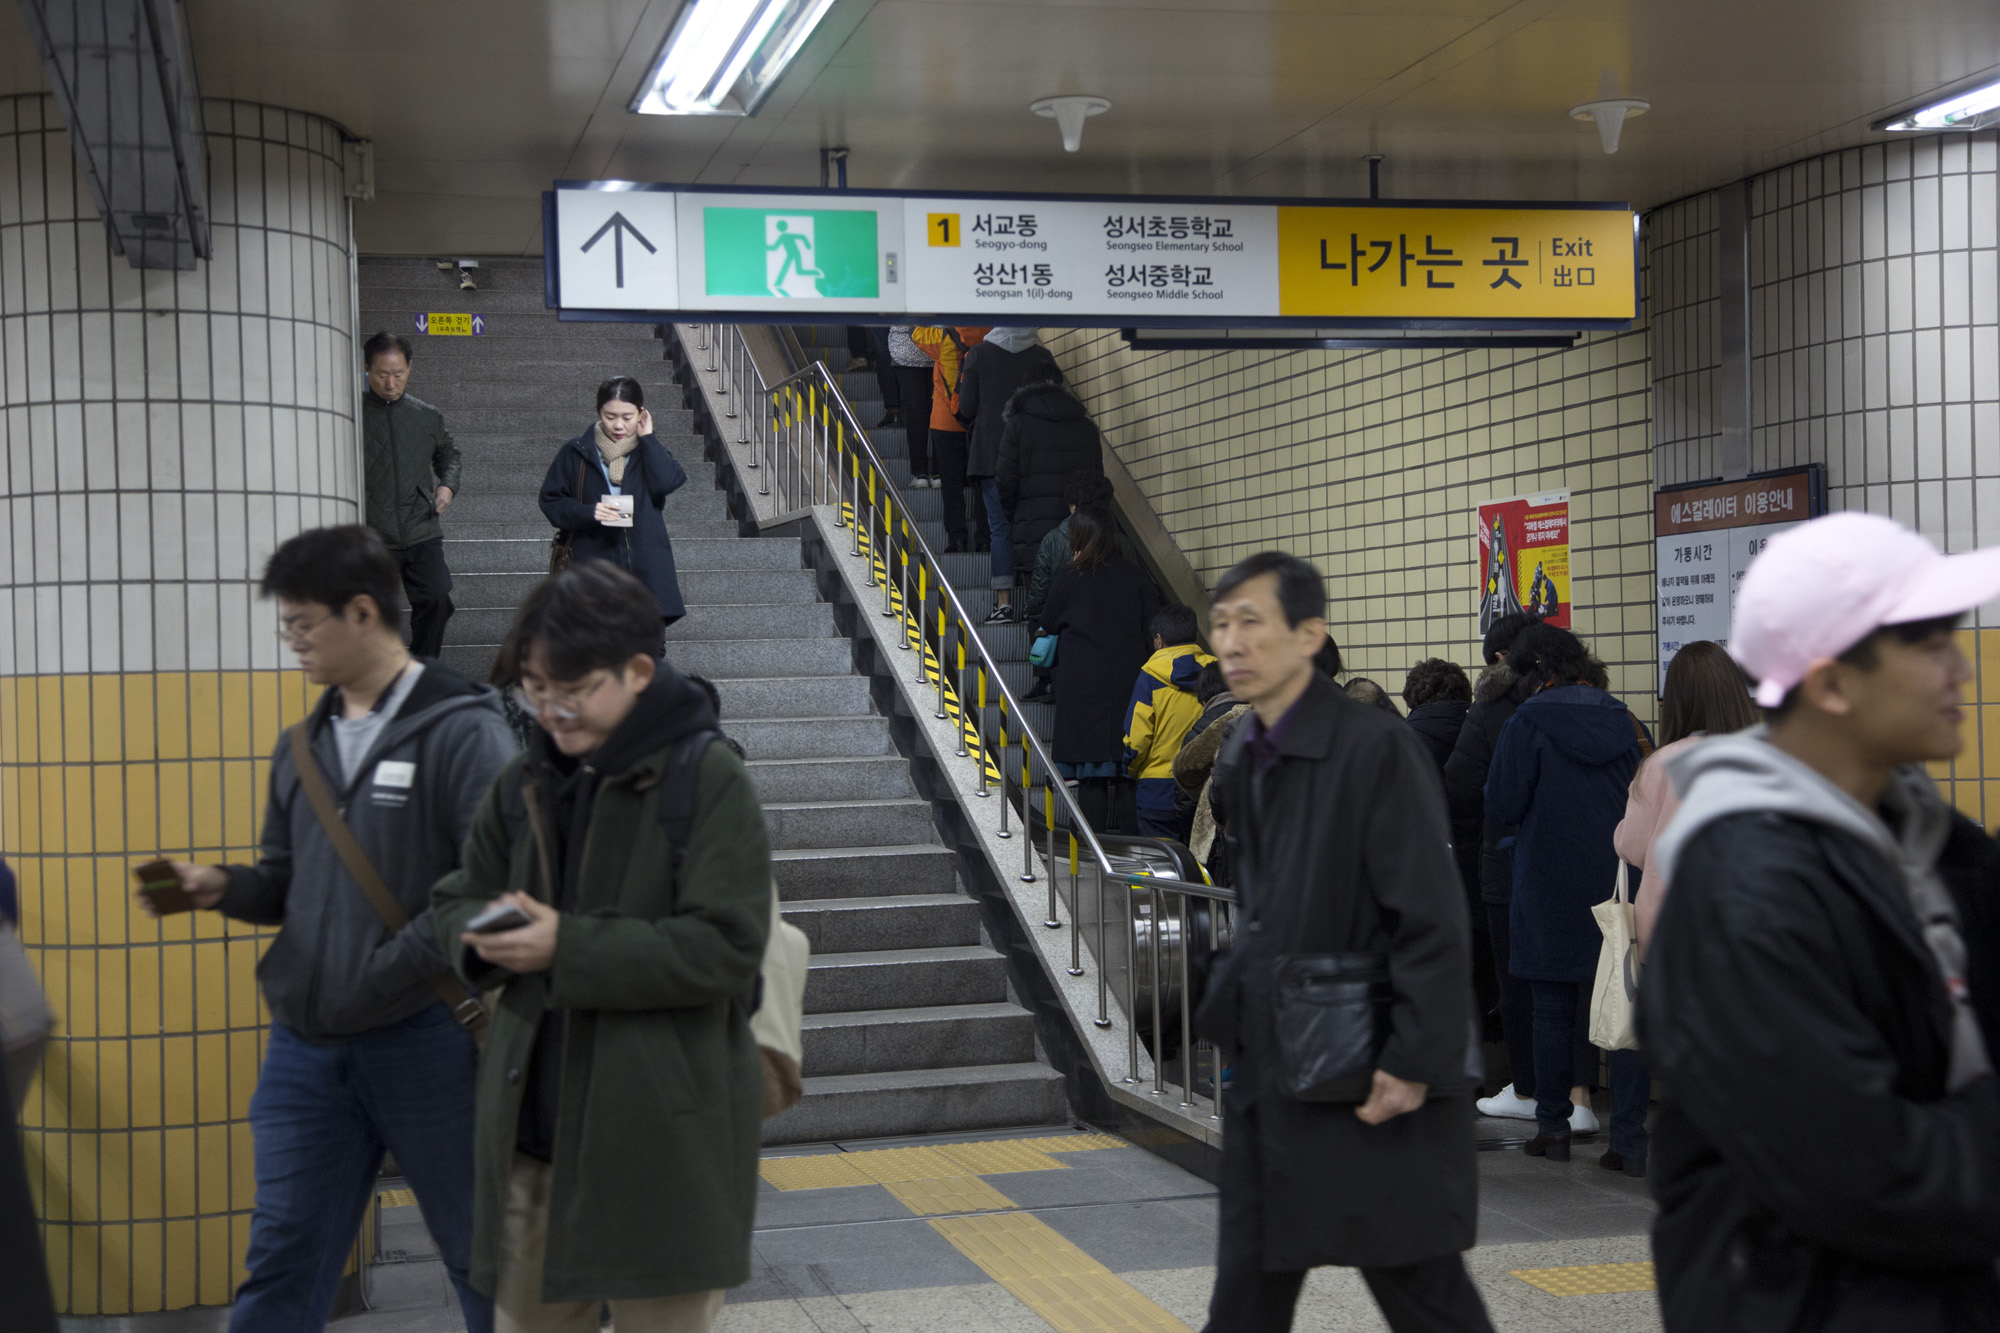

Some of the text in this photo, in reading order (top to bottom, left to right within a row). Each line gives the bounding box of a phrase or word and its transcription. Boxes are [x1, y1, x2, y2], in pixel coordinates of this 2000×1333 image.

[936, 218, 950, 243] 1
[972, 213, 1038, 237] 서교동
[1103, 215, 1234, 239] 성서초등학교
[975, 239, 1048, 251] Seogyo-dong
[1106, 240, 1244, 253] Seongseo Elementary School
[1552, 237, 1593, 257] Exit
[1320, 233, 1529, 290] 나가는 곳
[973, 263, 1053, 286] 성산1동
[1105, 264, 1213, 287] 성서중학교
[1553, 264, 1595, 287] 出口
[975, 288, 1073, 300] Seongsan 1(il)-dong
[1107, 289, 1223, 301] Seongseo Middle School
[430, 316, 470, 325] 오른쪽 걷기
[1670, 487, 1793, 524] 에스컬레이터 이용안내
[1674, 544, 1712, 563] 가동시간
